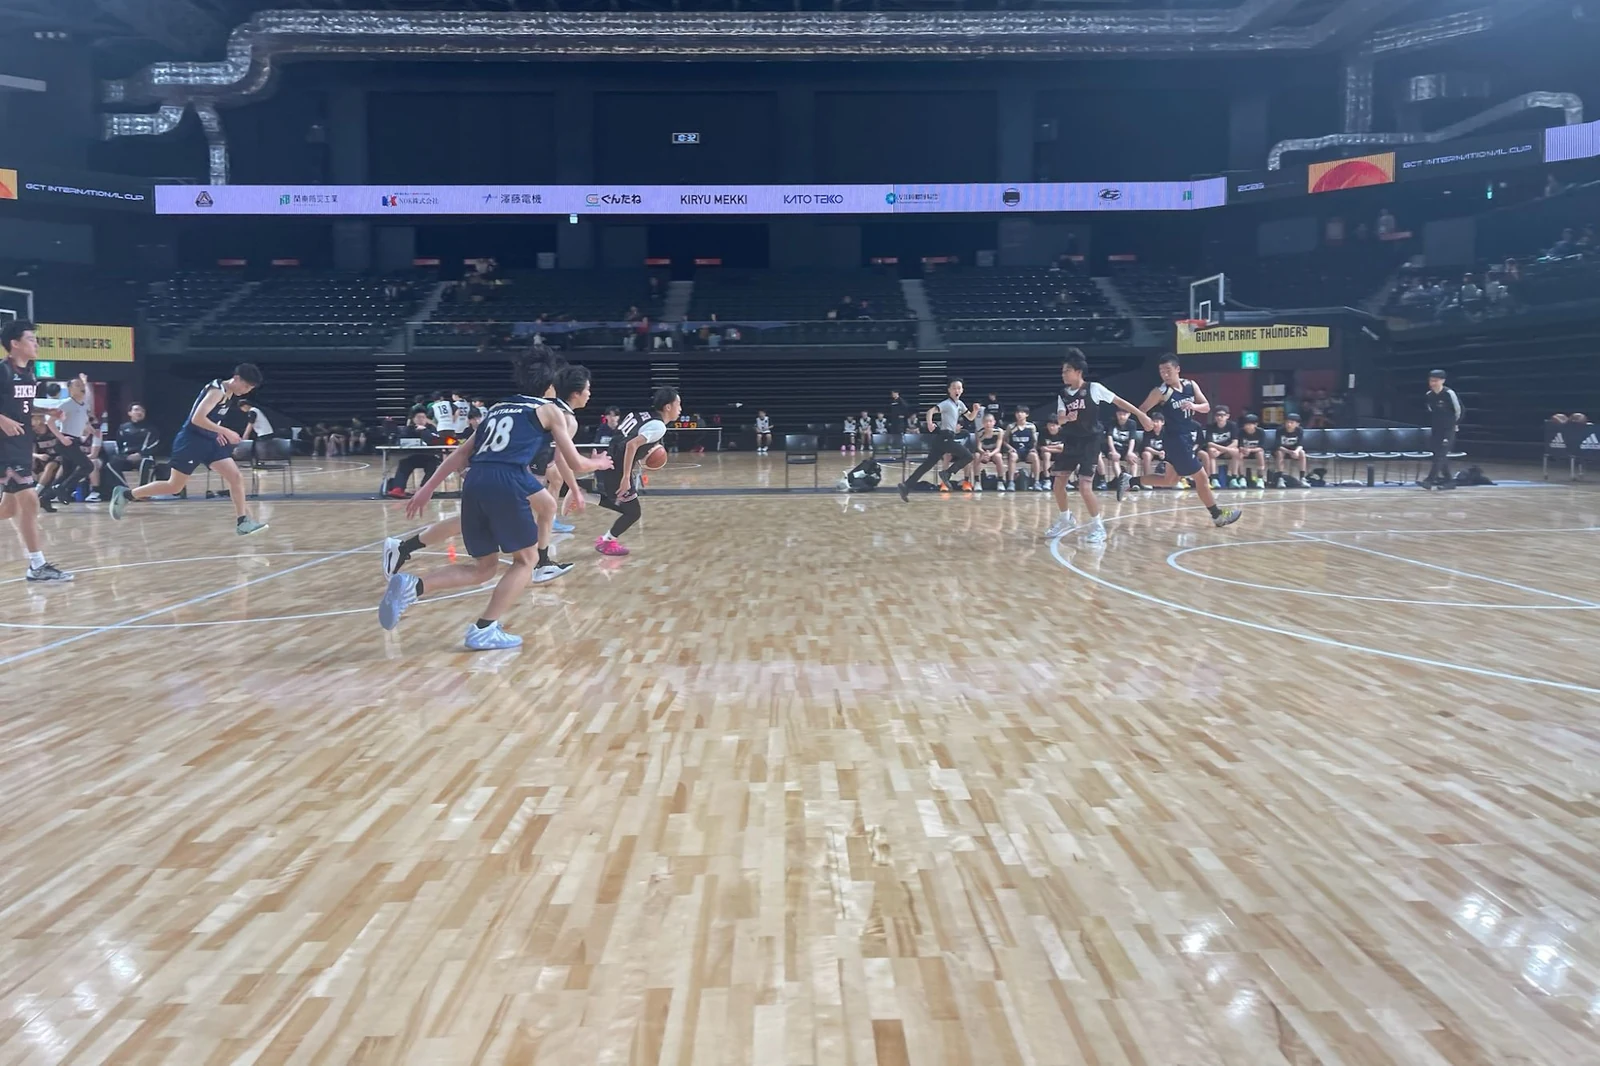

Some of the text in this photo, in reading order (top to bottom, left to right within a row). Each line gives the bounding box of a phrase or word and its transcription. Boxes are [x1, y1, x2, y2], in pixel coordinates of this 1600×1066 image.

[1402, 144, 1532, 169] GCT INTERNATIONAL CUP
[25, 183, 144, 201] GCT INTERNATIONAL CUP
[600, 193, 642, 205] ぐんたね
[680, 194, 748, 205] KIRYU MEKKI
[783, 194, 844, 205] KATO TEKKO
[1195, 326, 1308, 343] GUNMA CRANE THUNDERS
[57, 337, 112, 349] THUNDERS
[23, 401, 30, 414] 5
[437, 404, 449, 415] 18
[476, 416, 514, 456] 28
